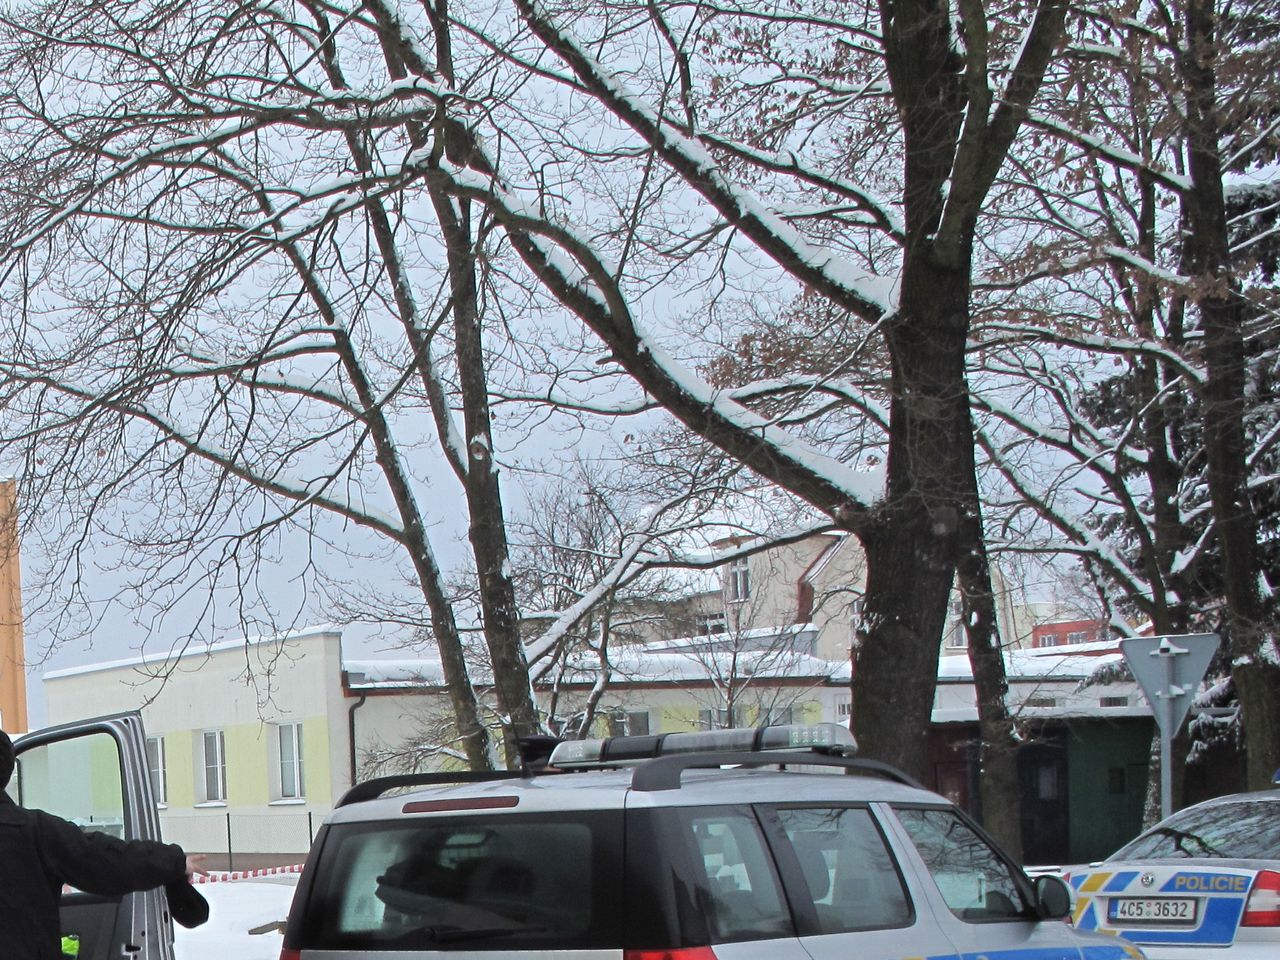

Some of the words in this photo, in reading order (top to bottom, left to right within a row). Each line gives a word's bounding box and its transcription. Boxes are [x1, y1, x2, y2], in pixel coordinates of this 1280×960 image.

[1175, 876, 1248, 891] POLICIE
[1120, 902, 1144, 917] 4C5
[1154, 902, 1188, 917] 3632
